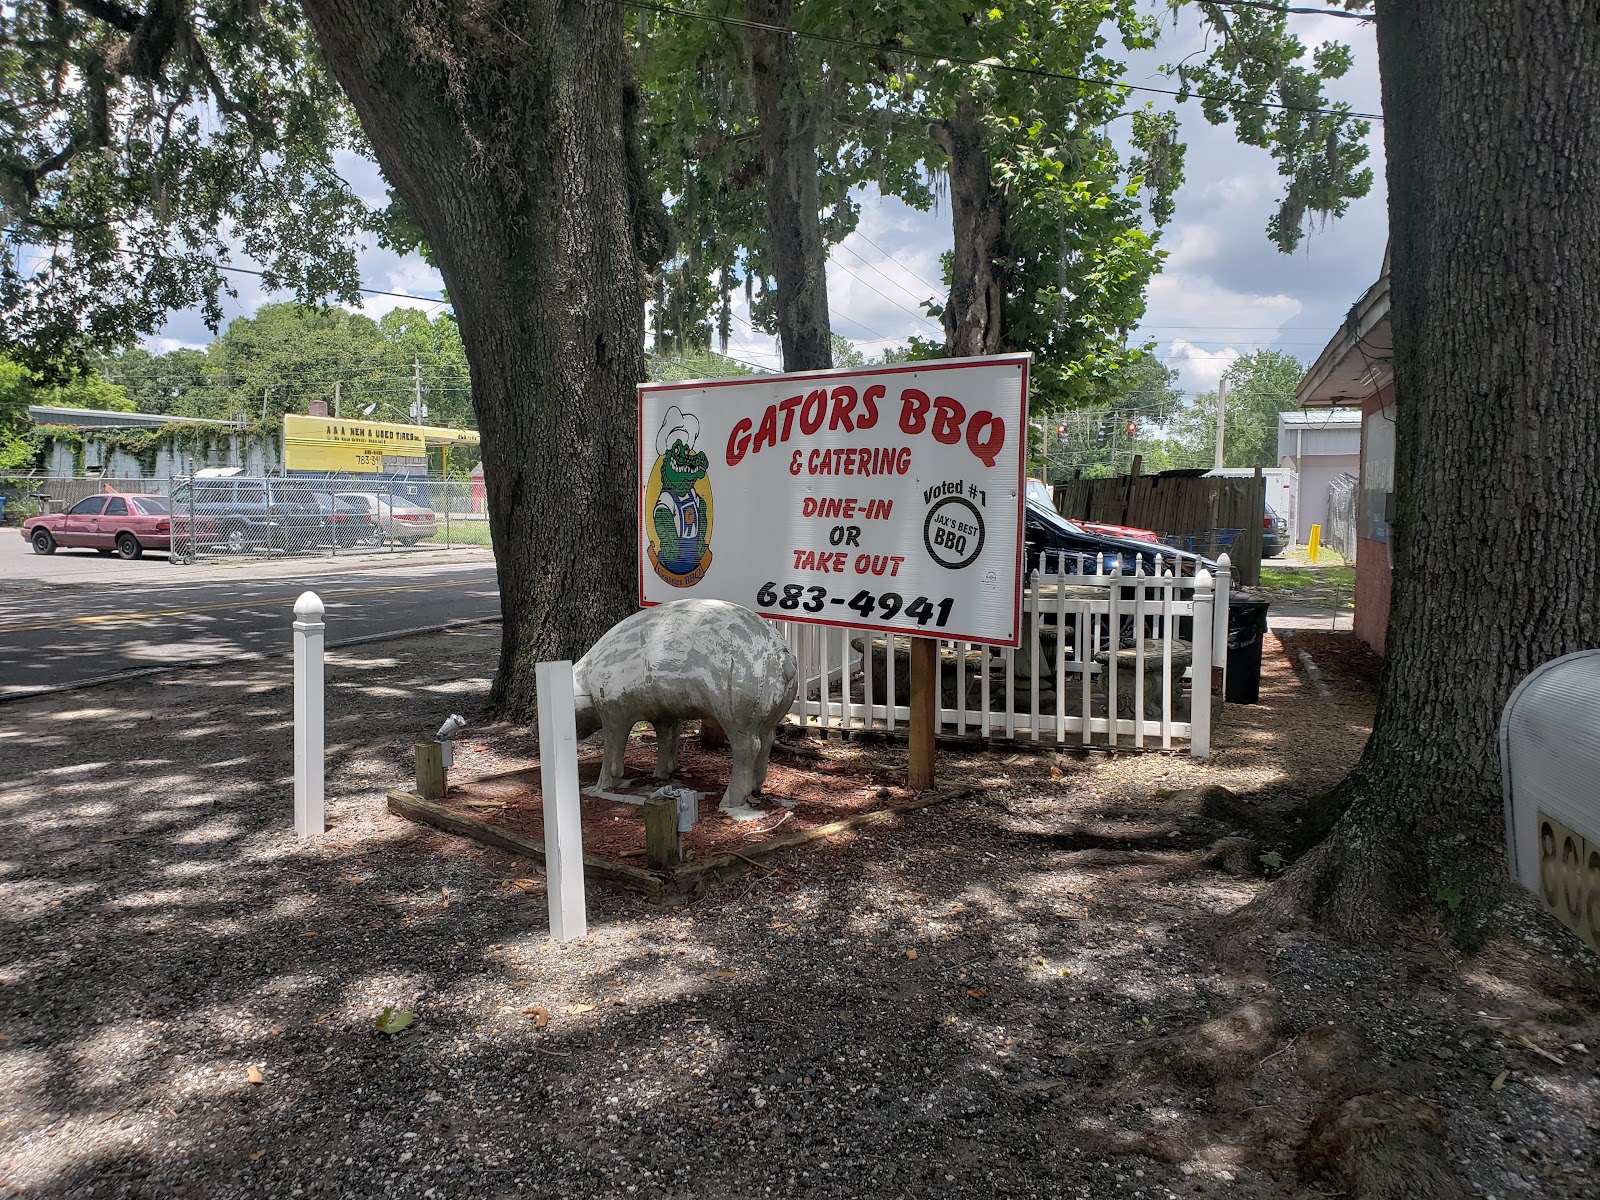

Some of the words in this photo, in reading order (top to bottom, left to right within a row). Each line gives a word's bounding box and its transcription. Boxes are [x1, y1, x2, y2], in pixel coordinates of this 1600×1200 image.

[376, 430, 393, 438] USED
[726, 385, 886, 466] GATORS
[899, 389, 1005, 467] BBQ
[790, 450, 802, 475] &
[808, 447, 911, 477] CATERING
[924, 480, 963, 505] Voted
[968, 484, 986, 507] #1
[802, 497, 893, 520] DINE-IN
[829, 526, 861, 547] OR
[934, 514, 957, 528] JAX'S
[958, 522, 978, 536] BEST
[933, 527, 967, 556] BBQ
[793, 550, 848, 573] TAKE
[854, 554, 905, 577] OUT
[756, 581, 954, 627] 683-4941
